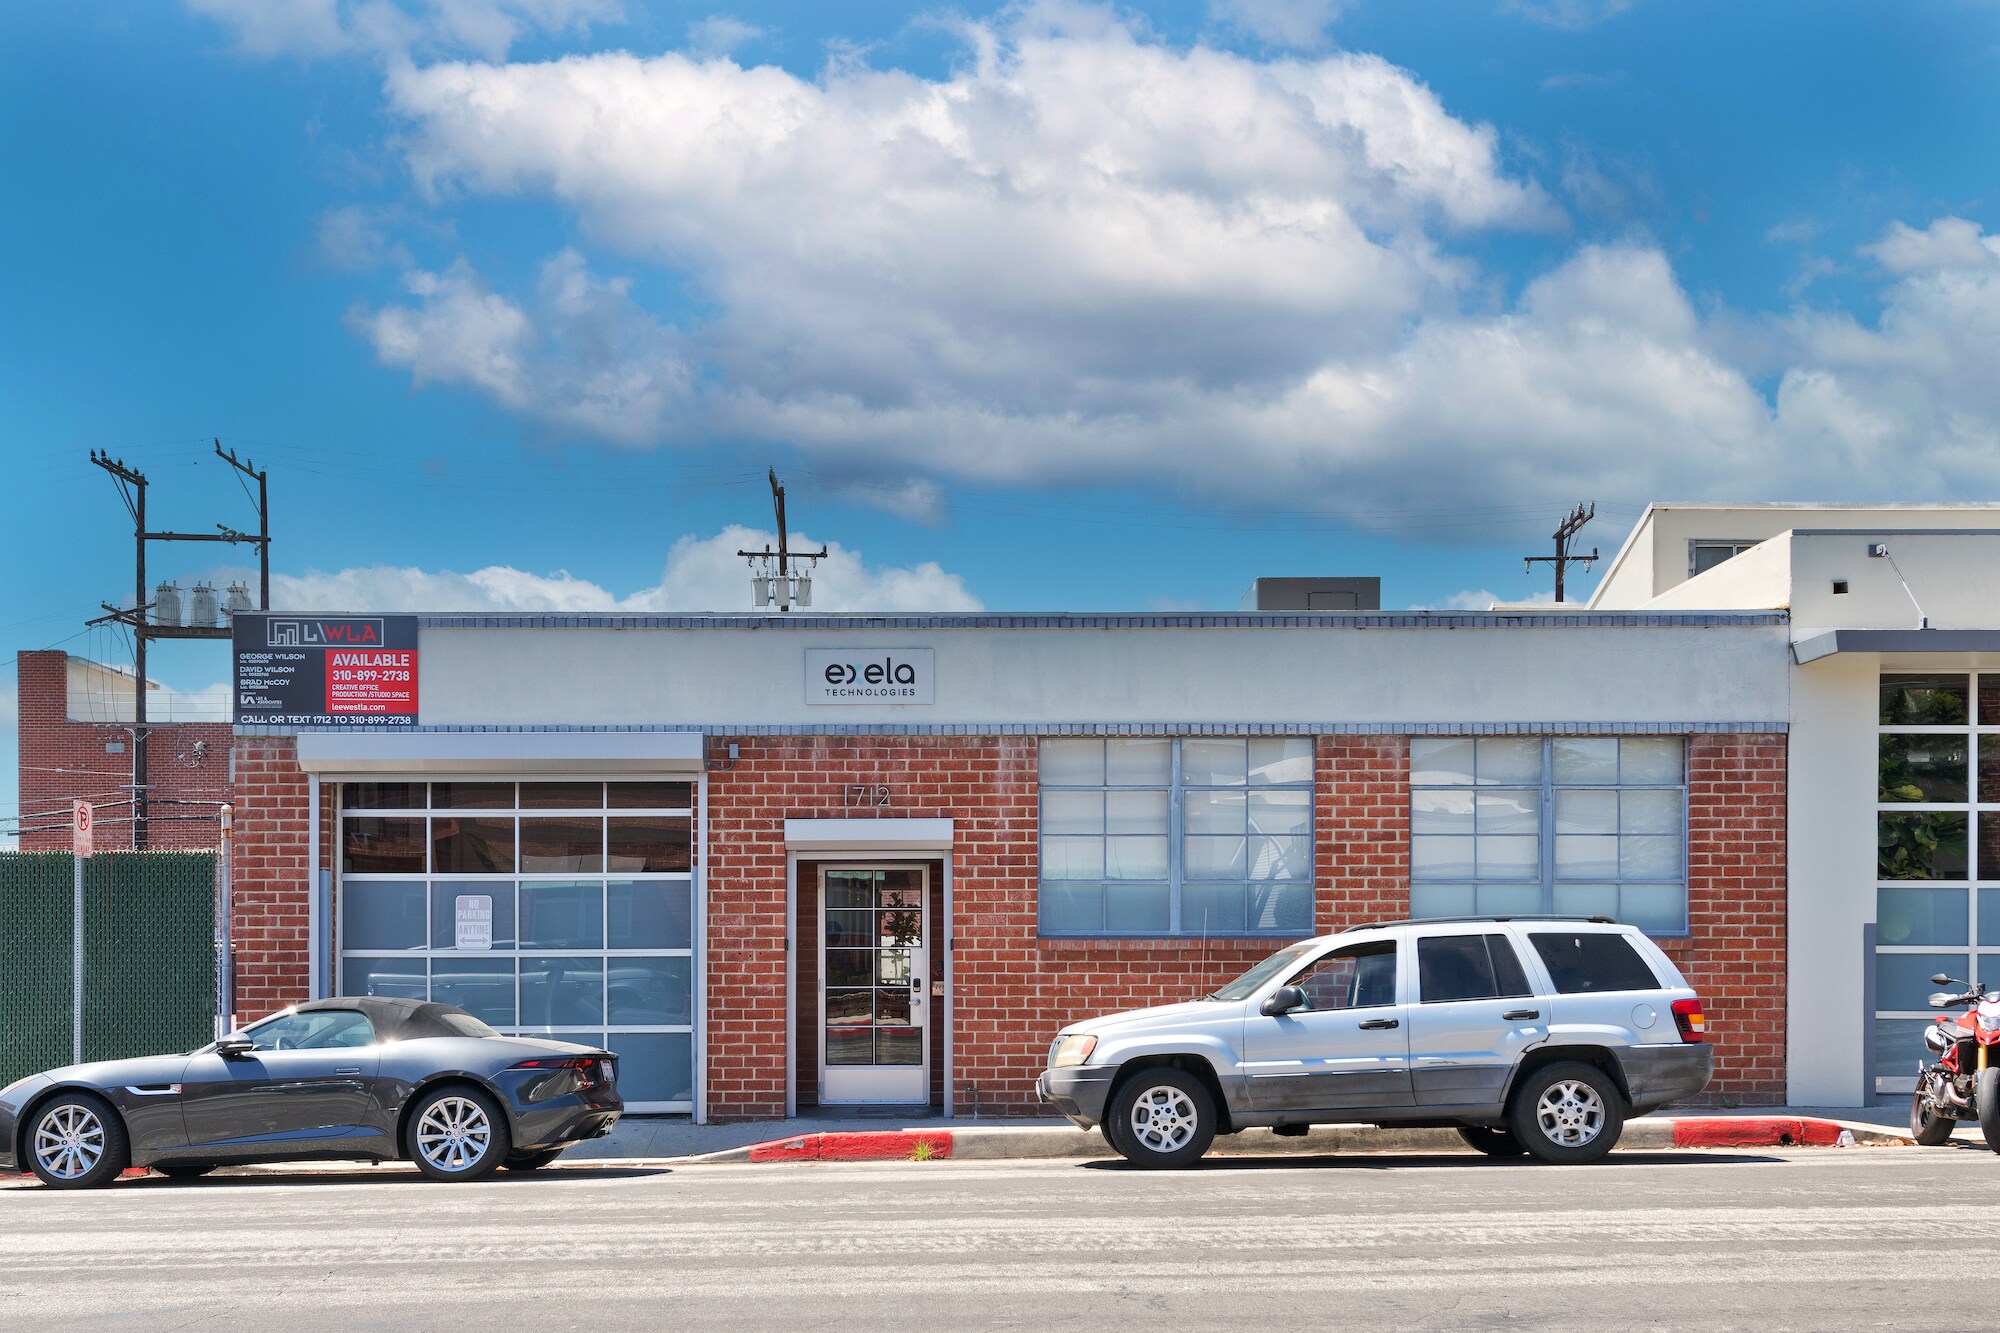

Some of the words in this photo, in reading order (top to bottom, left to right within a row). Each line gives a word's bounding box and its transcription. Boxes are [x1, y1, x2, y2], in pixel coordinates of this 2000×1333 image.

[332, 653, 410, 667] AVAILABLE
[332, 670, 410, 681] 310-899-2738
[825, 657, 915, 685] exela
[825, 689, 915, 697] TECHNOLOGIES
[331, 703, 386, 711] leewestla.com
[241, 715, 267, 724] CALL
[269, 715, 285, 724] OR
[287, 715, 311, 724] TEXT
[312, 715, 331, 724] 1712
[333, 716, 348, 724] TO
[350, 716, 411, 724] 310-899-2738
[844, 784, 891, 807] 1712
[468, 899, 480, 909] NO
[457, 910, 490, 920] PARKING
[458, 924, 489, 935] ANYTIME
